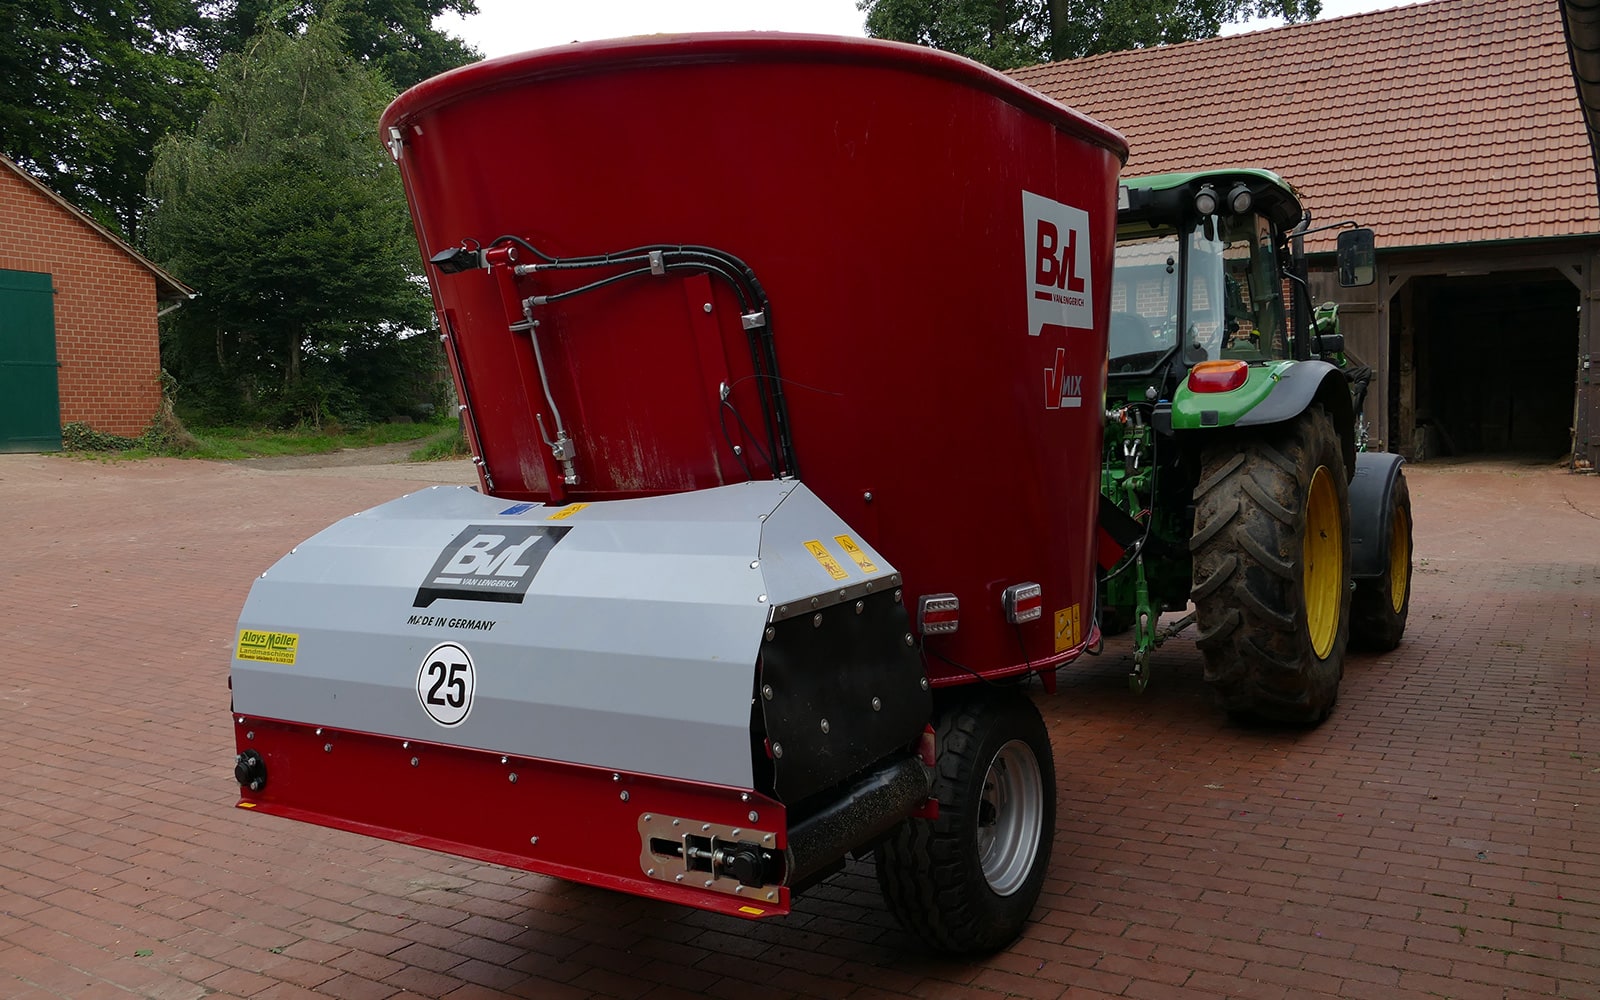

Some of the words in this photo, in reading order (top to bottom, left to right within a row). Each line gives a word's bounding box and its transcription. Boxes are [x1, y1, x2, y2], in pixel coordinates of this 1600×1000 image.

[462, 578, 478, 586] VAN
[477, 579, 519, 588] LENGERICH
[407, 615, 434, 627] MADE
[435, 617, 447, 627] IN
[448, 618, 496, 631] GERMANY
[241, 631, 265, 644] Aloys
[265, 633, 296, 650] Möller
[240, 647, 294, 658] Landmaschinen
[427, 661, 467, 708] 25
